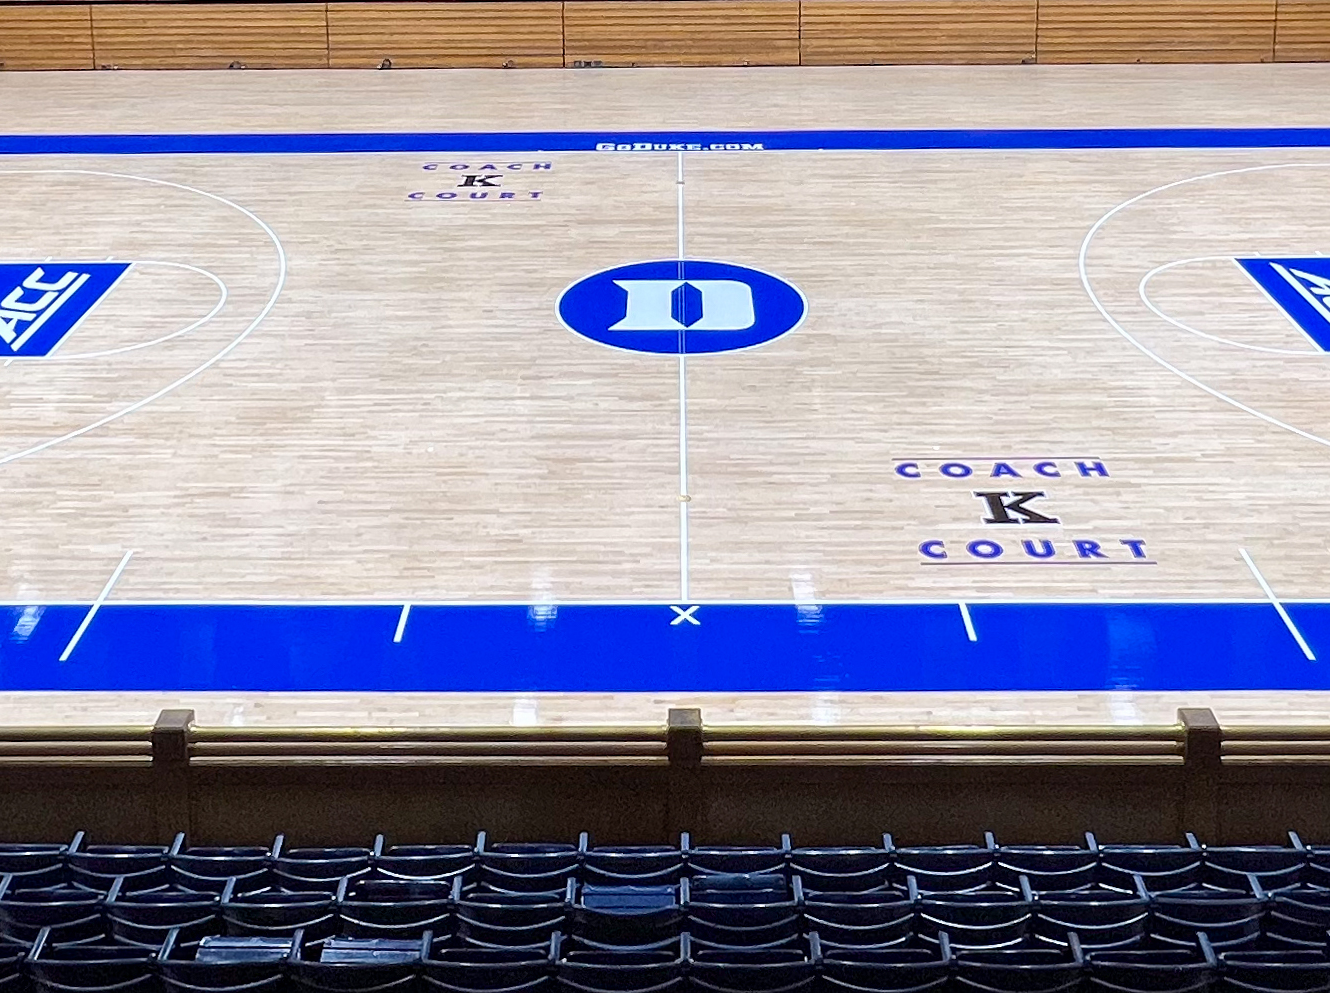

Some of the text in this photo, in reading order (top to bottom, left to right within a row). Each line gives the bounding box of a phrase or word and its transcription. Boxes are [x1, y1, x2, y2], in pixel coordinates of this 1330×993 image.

[422, 162, 552, 171] COACH
[457, 174, 504, 188] K
[407, 191, 543, 200] COURT
[894, 461, 1110, 478] COACH
[972, 490, 1062, 525] K
[918, 539, 1147, 559] COURT
